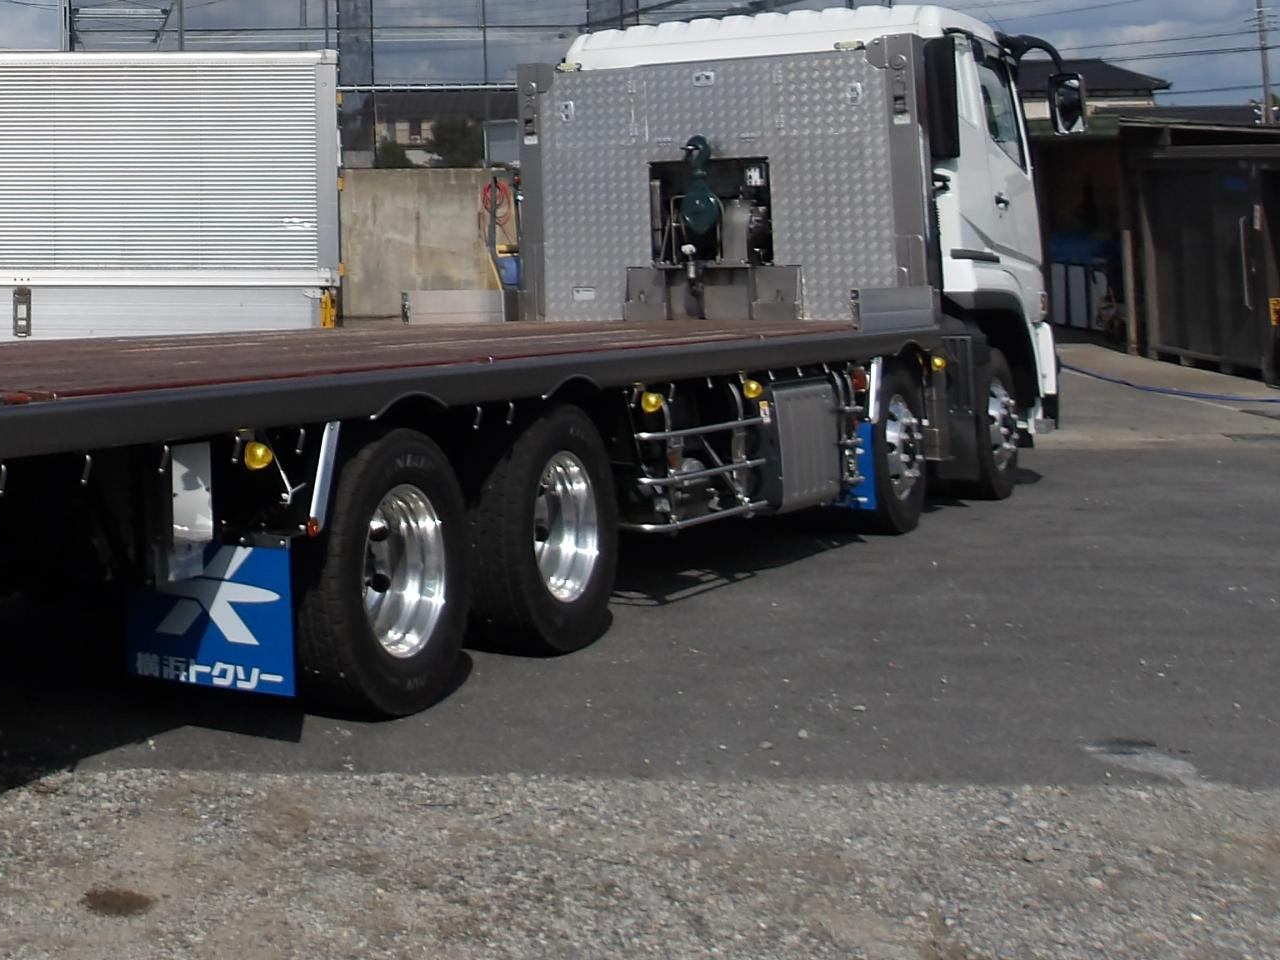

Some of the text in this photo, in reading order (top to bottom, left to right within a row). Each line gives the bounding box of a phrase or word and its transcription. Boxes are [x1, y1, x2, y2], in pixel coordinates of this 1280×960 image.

[136, 652, 284, 689] 横浜トクソー
